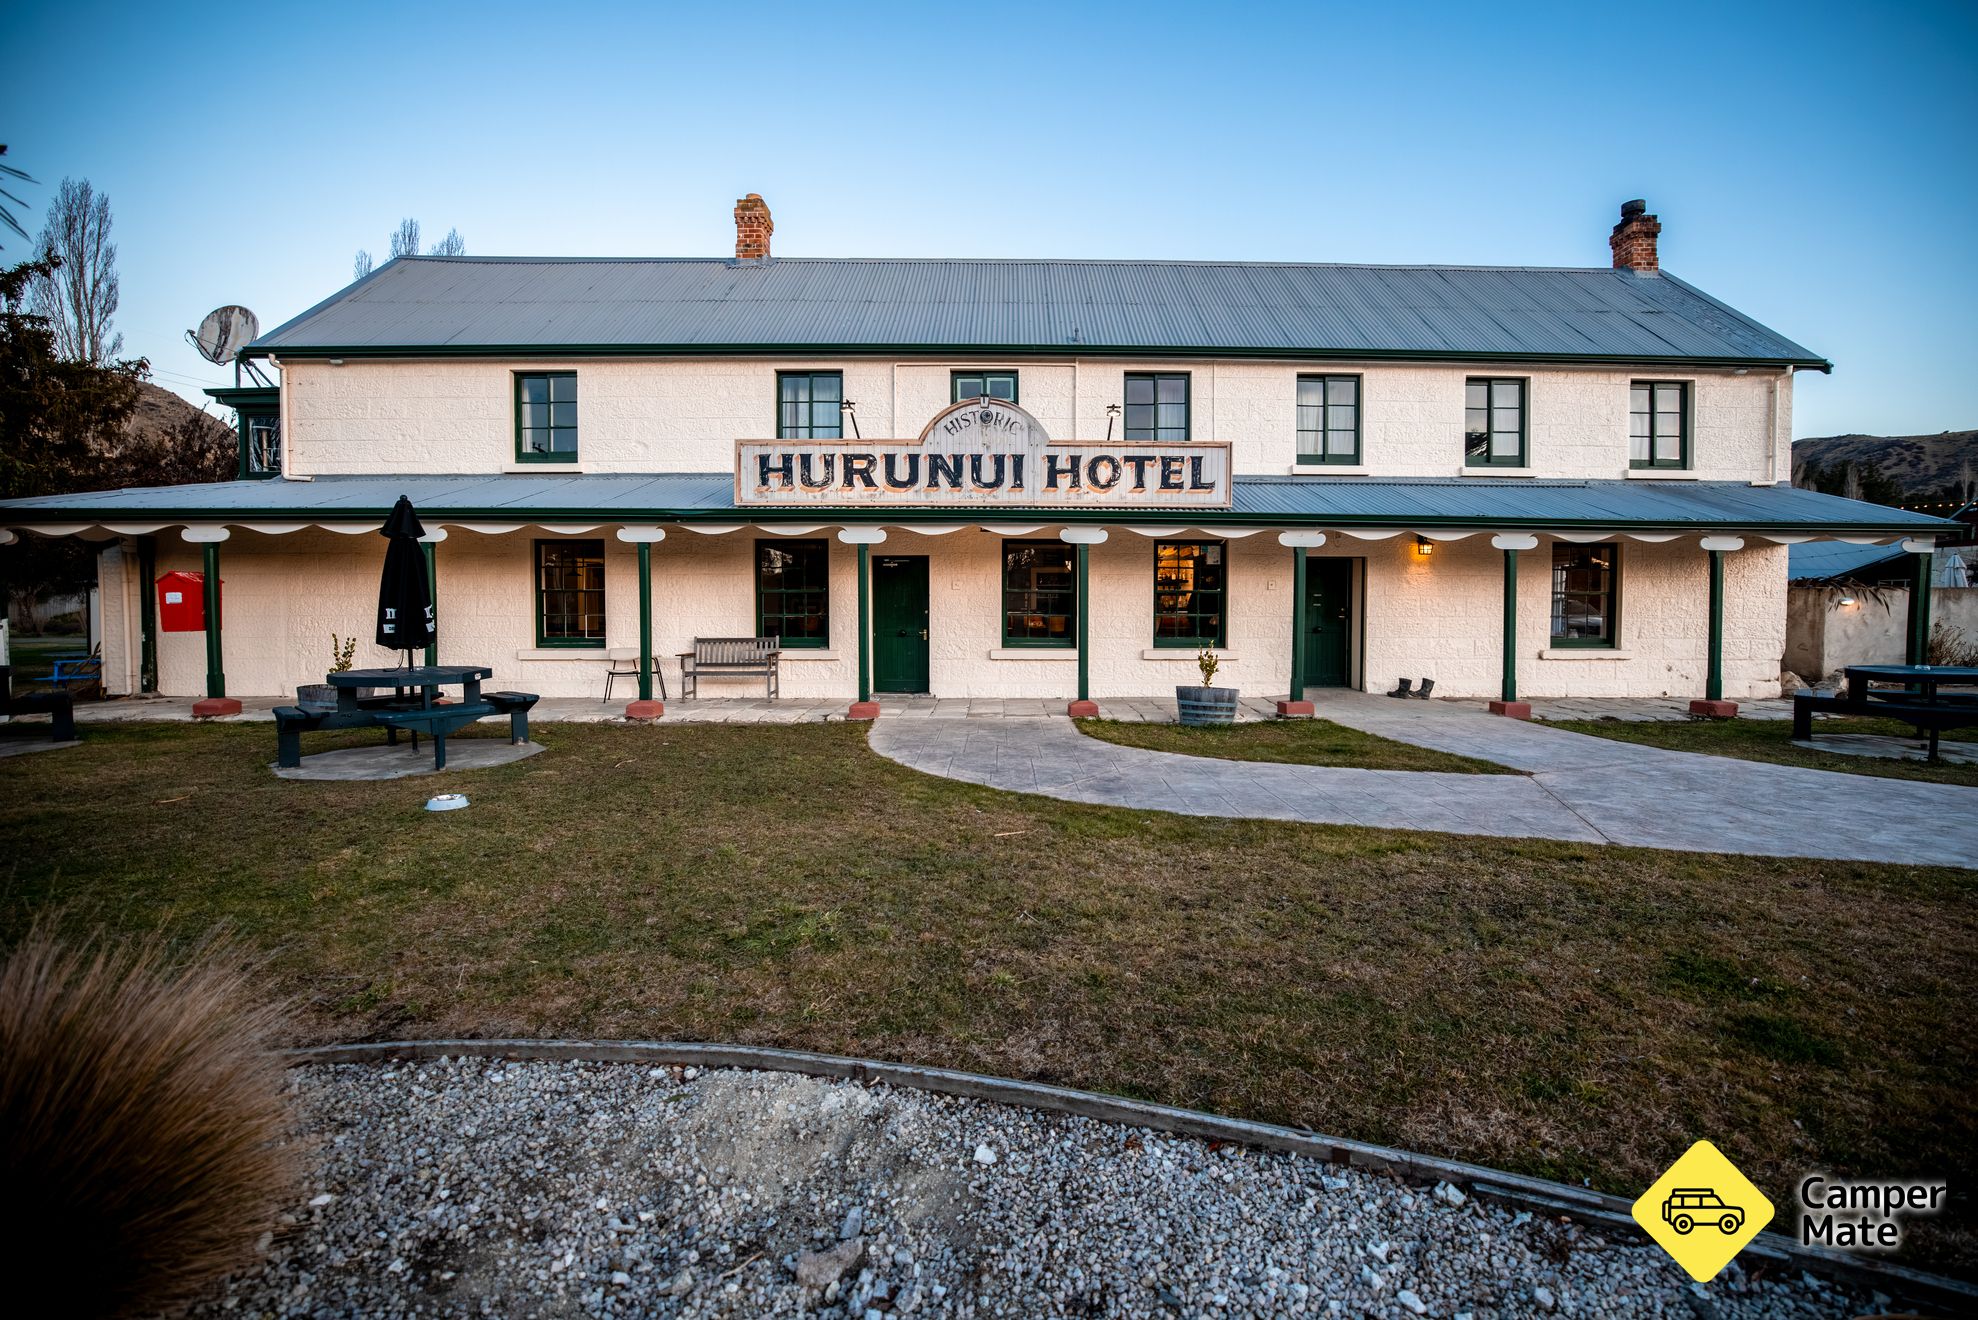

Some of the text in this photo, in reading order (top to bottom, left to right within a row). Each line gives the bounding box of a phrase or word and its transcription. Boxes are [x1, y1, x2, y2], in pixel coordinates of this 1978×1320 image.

[943, 409, 1023, 436] HISTORIC
[754, 453, 1216, 494] HURUNUI HOTEL
